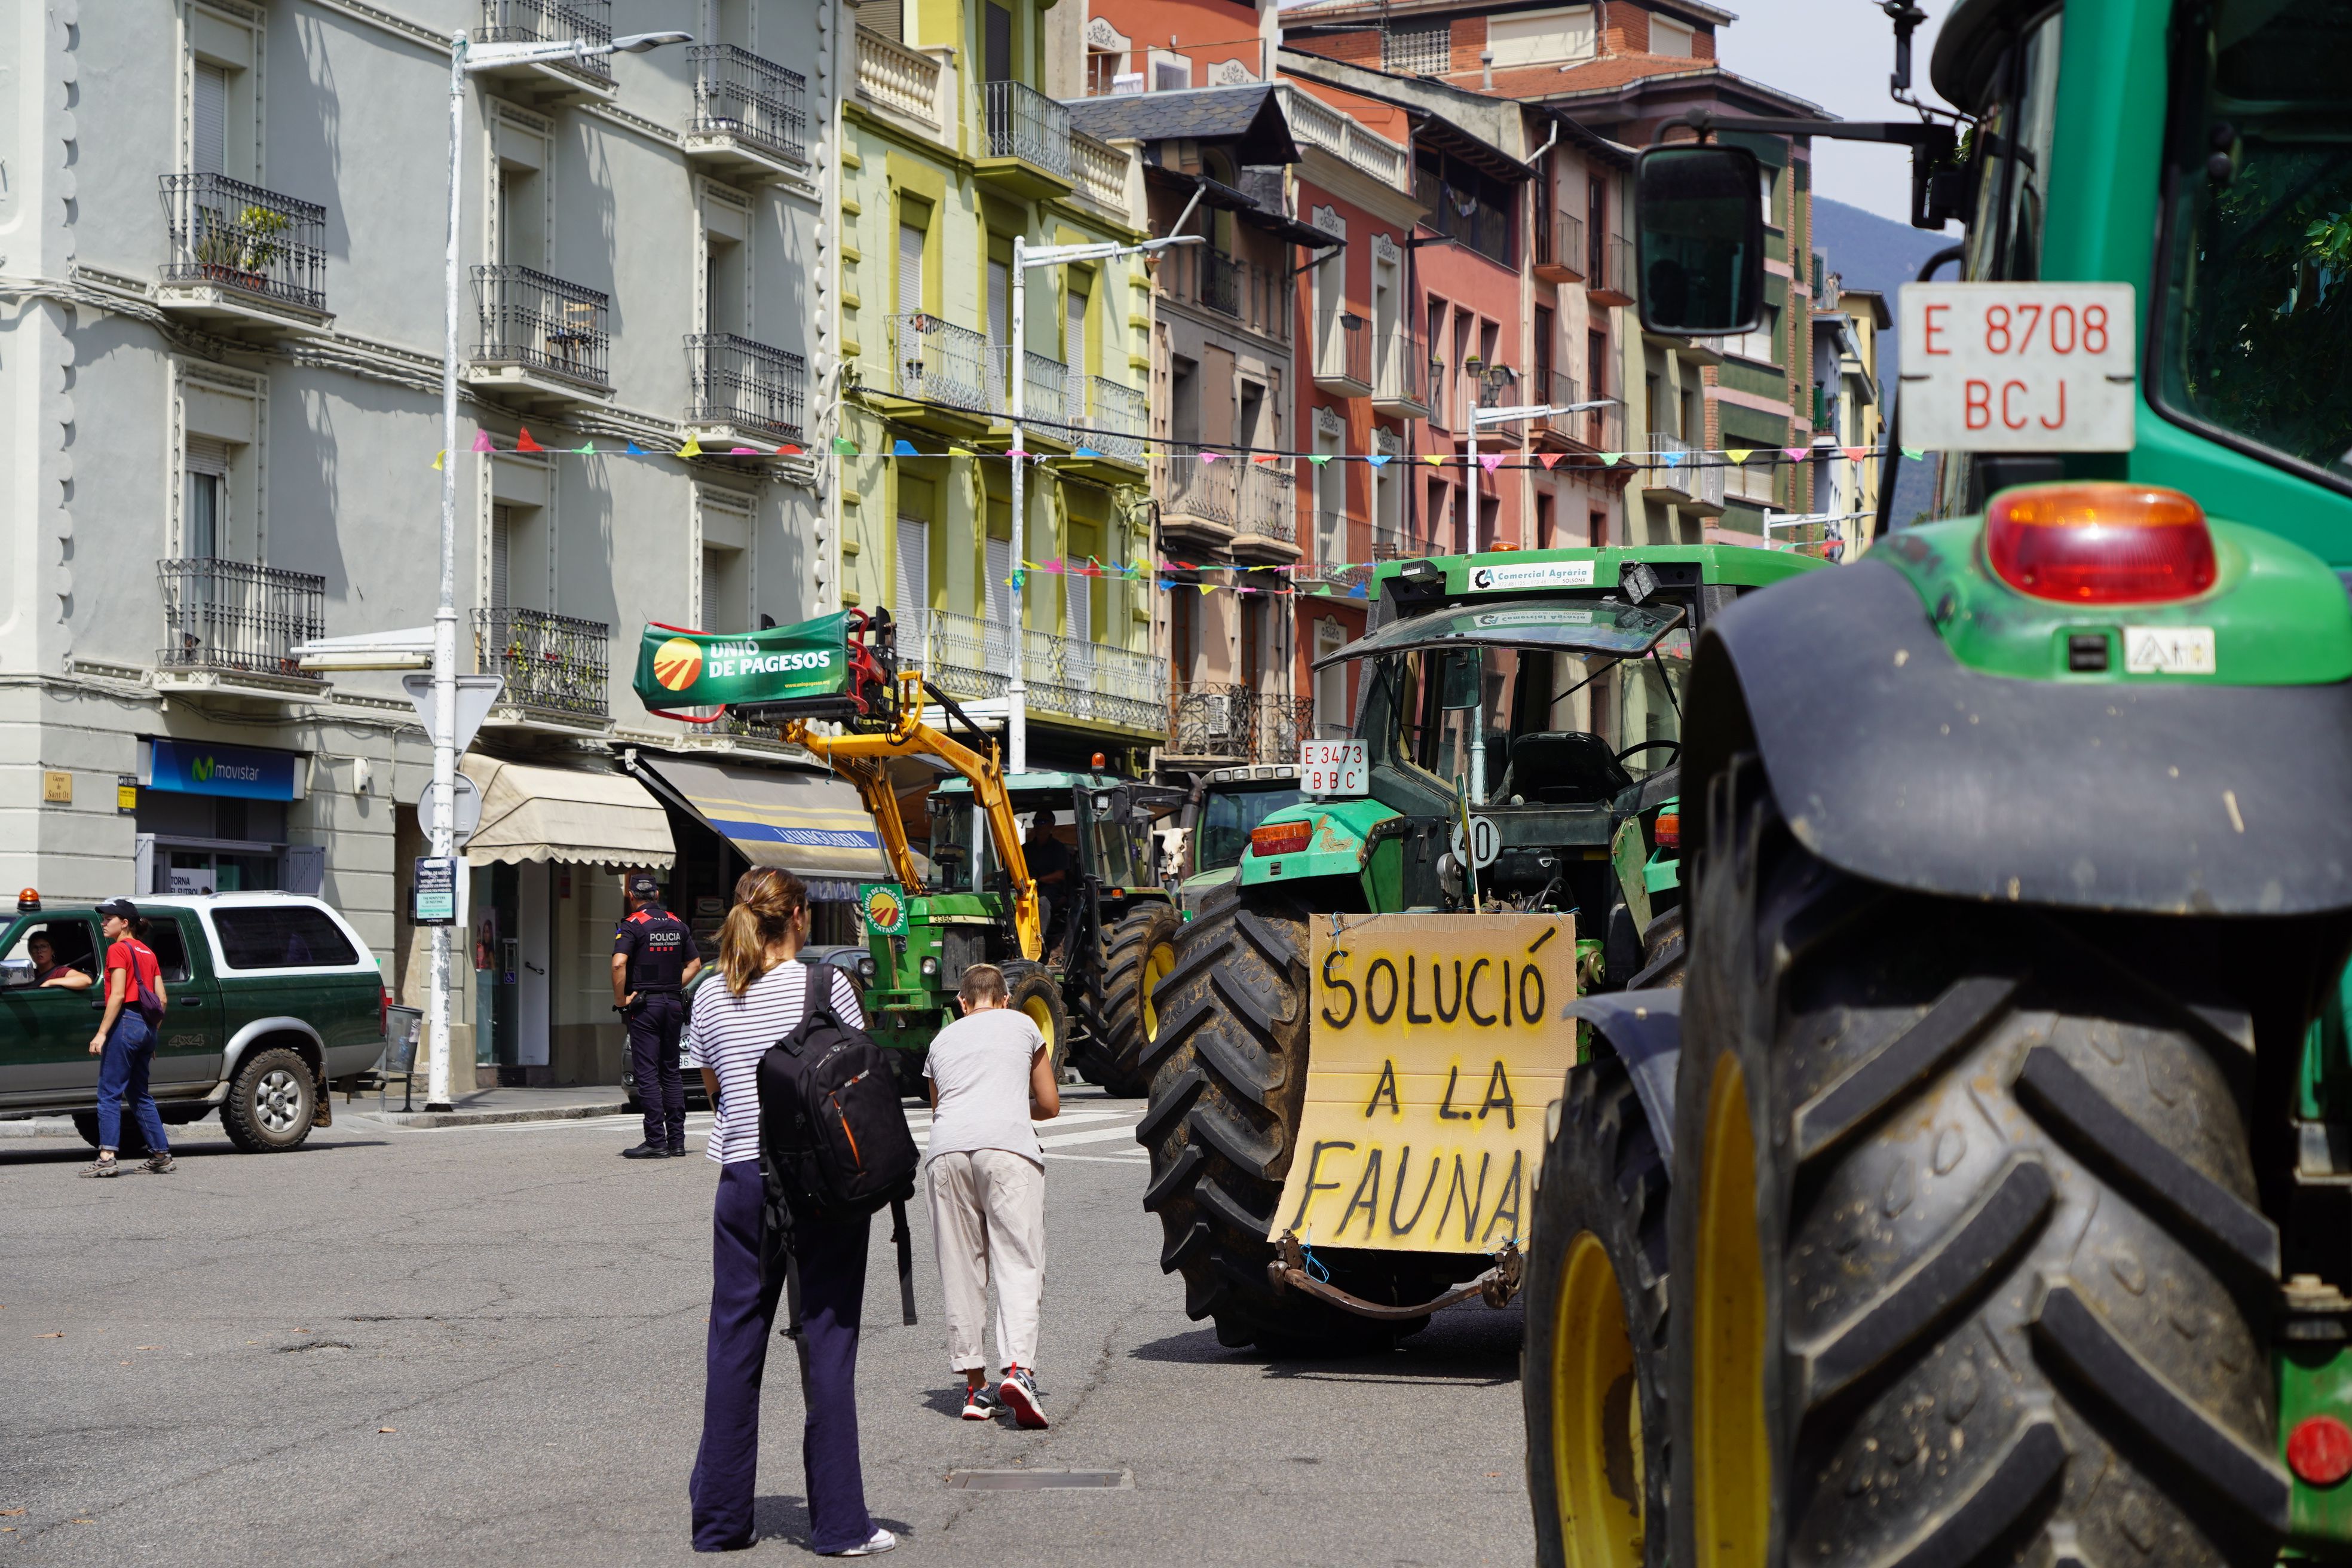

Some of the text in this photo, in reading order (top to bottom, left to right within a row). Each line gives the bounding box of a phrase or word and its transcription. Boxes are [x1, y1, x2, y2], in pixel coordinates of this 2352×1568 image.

[1925, 303, 2109, 355] E 8708
[1965, 379, 2067, 430] BCJ
[1498, 569, 1545, 580] Comercial
[710, 636, 760, 659] UNIÓ
[709, 651, 831, 678] DE PAGESOS
[1306, 746, 1362, 764] E 3473
[215, 764, 260, 781] movistar
[1313, 771, 1355, 789] BBC
[62, 791, 69, 799] Ot
[170, 875, 190, 885] TORNA
[871, 887, 880, 895] DE
[880, 886, 904, 911] PAGESOS
[866, 913, 905, 933] DE CATALUNYA
[650, 933, 681, 941] POLICIA
[1322, 927, 1556, 1030] SOLUCIÓ
[168, 1034, 204, 1047] 4x4
[1365, 1059, 1399, 1117] A
[1291, 1141, 1523, 1244] FAUNA
